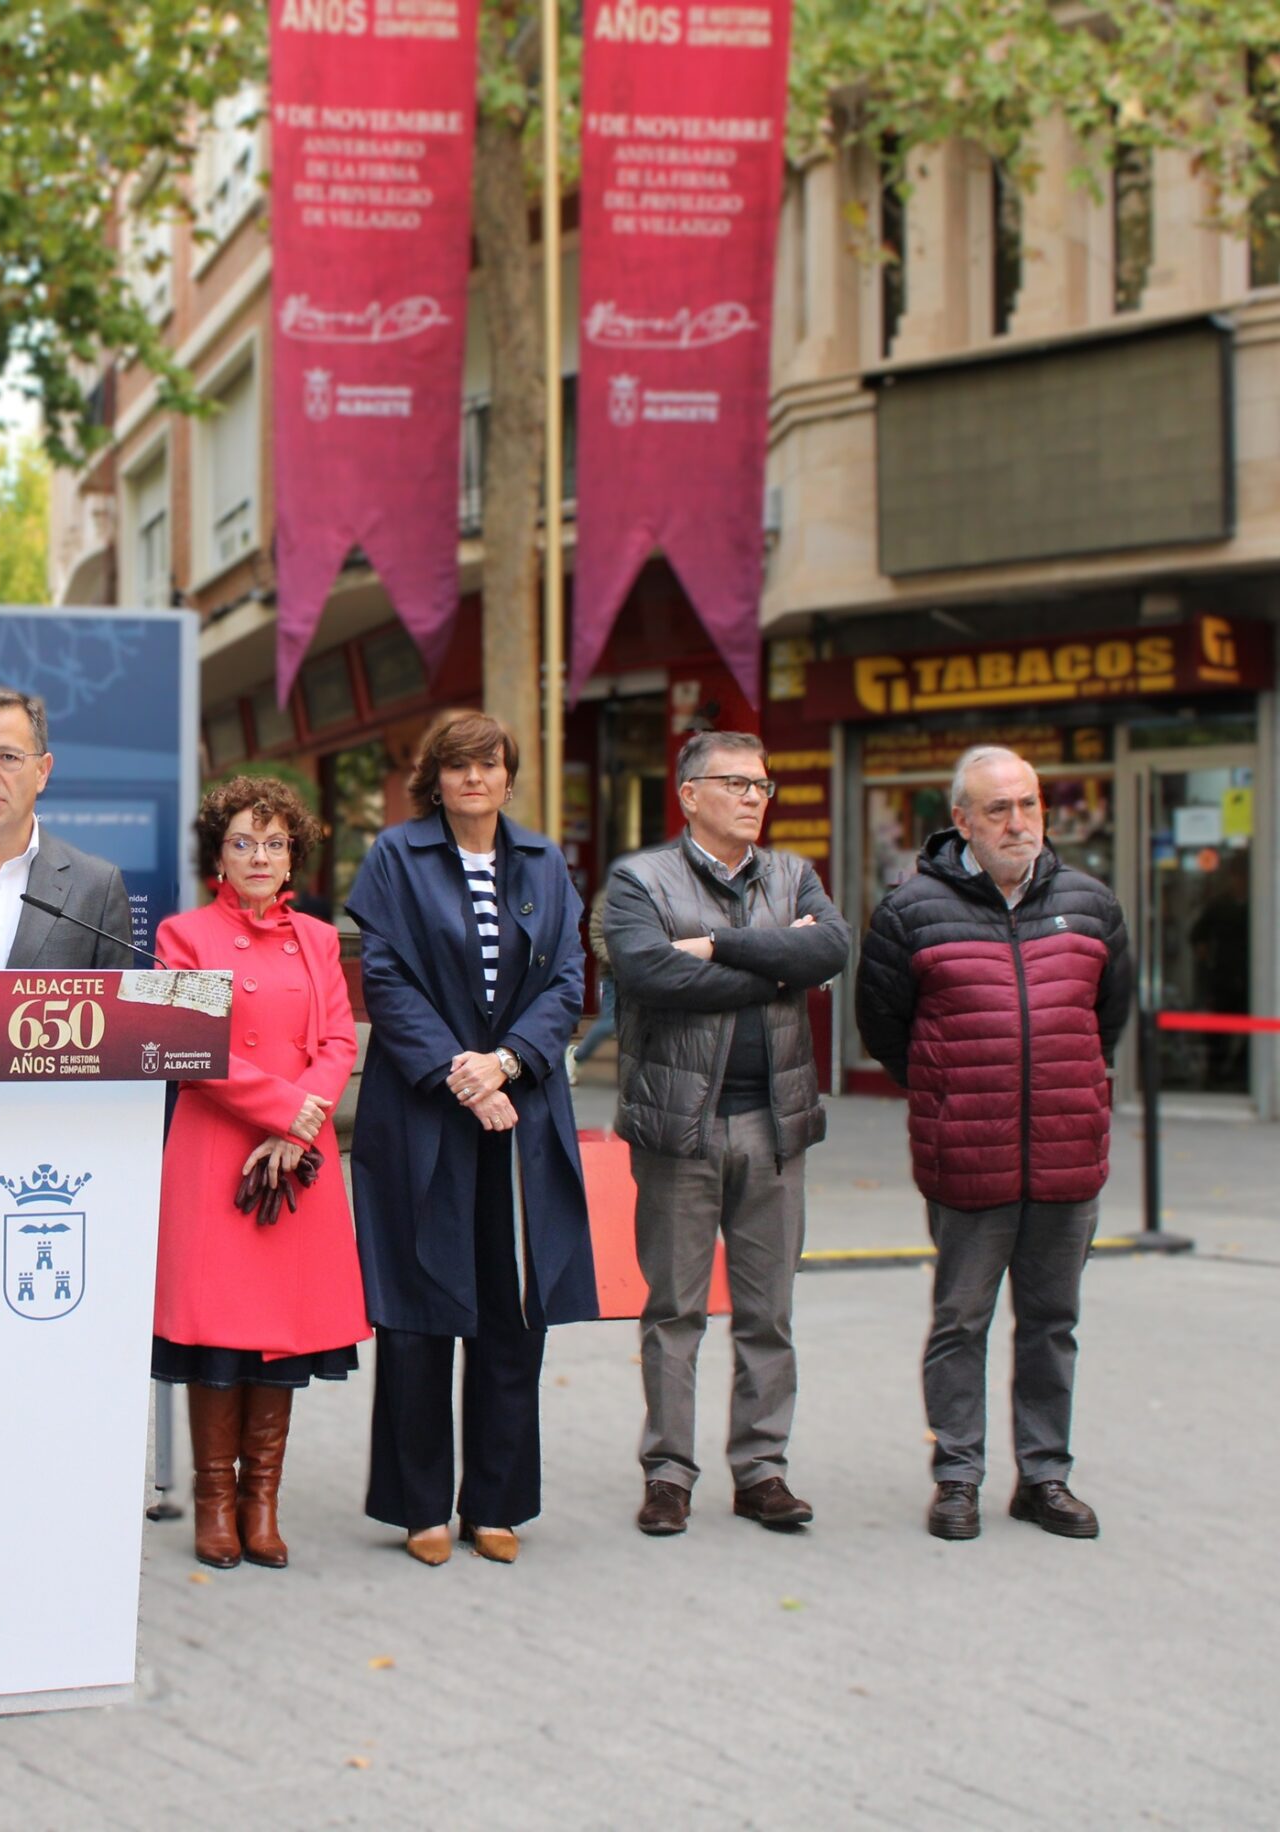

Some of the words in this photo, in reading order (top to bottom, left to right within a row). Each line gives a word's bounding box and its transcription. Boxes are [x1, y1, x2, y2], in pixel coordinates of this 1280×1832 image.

[594, 0, 681, 44] AÑOS
[288, 106, 315, 128] DE
[321, 108, 463, 134] NOVIEMBRE
[600, 115, 628, 138] DE
[633, 117, 773, 141] NOVIEMBRE
[303, 137, 426, 159] ANIVERSARIO
[615, 146, 737, 167] ANIVERSARIO
[306, 160, 328, 179] DE
[617, 169, 639, 187] DE
[293, 183, 324, 201] DEL
[603, 191, 634, 210] DEL
[302, 208, 324, 226] DE
[612, 216, 635, 234] DE
[913, 636, 1176, 693] TABACOS
[128, 894, 148, 902] nidad
[11, 978, 105, 995] ALBACETE
[7, 998, 106, 1051] 650
[9, 1052, 56, 1074] AÑOS
[60, 1055, 69, 1064] DE
[70, 1055, 100, 1064] HISTORIA
[164, 1051, 212, 1060] Ayuntamiento
[60, 1065, 100, 1074] COMPARTIDA
[163, 1060, 212, 1070] ALBACETE
